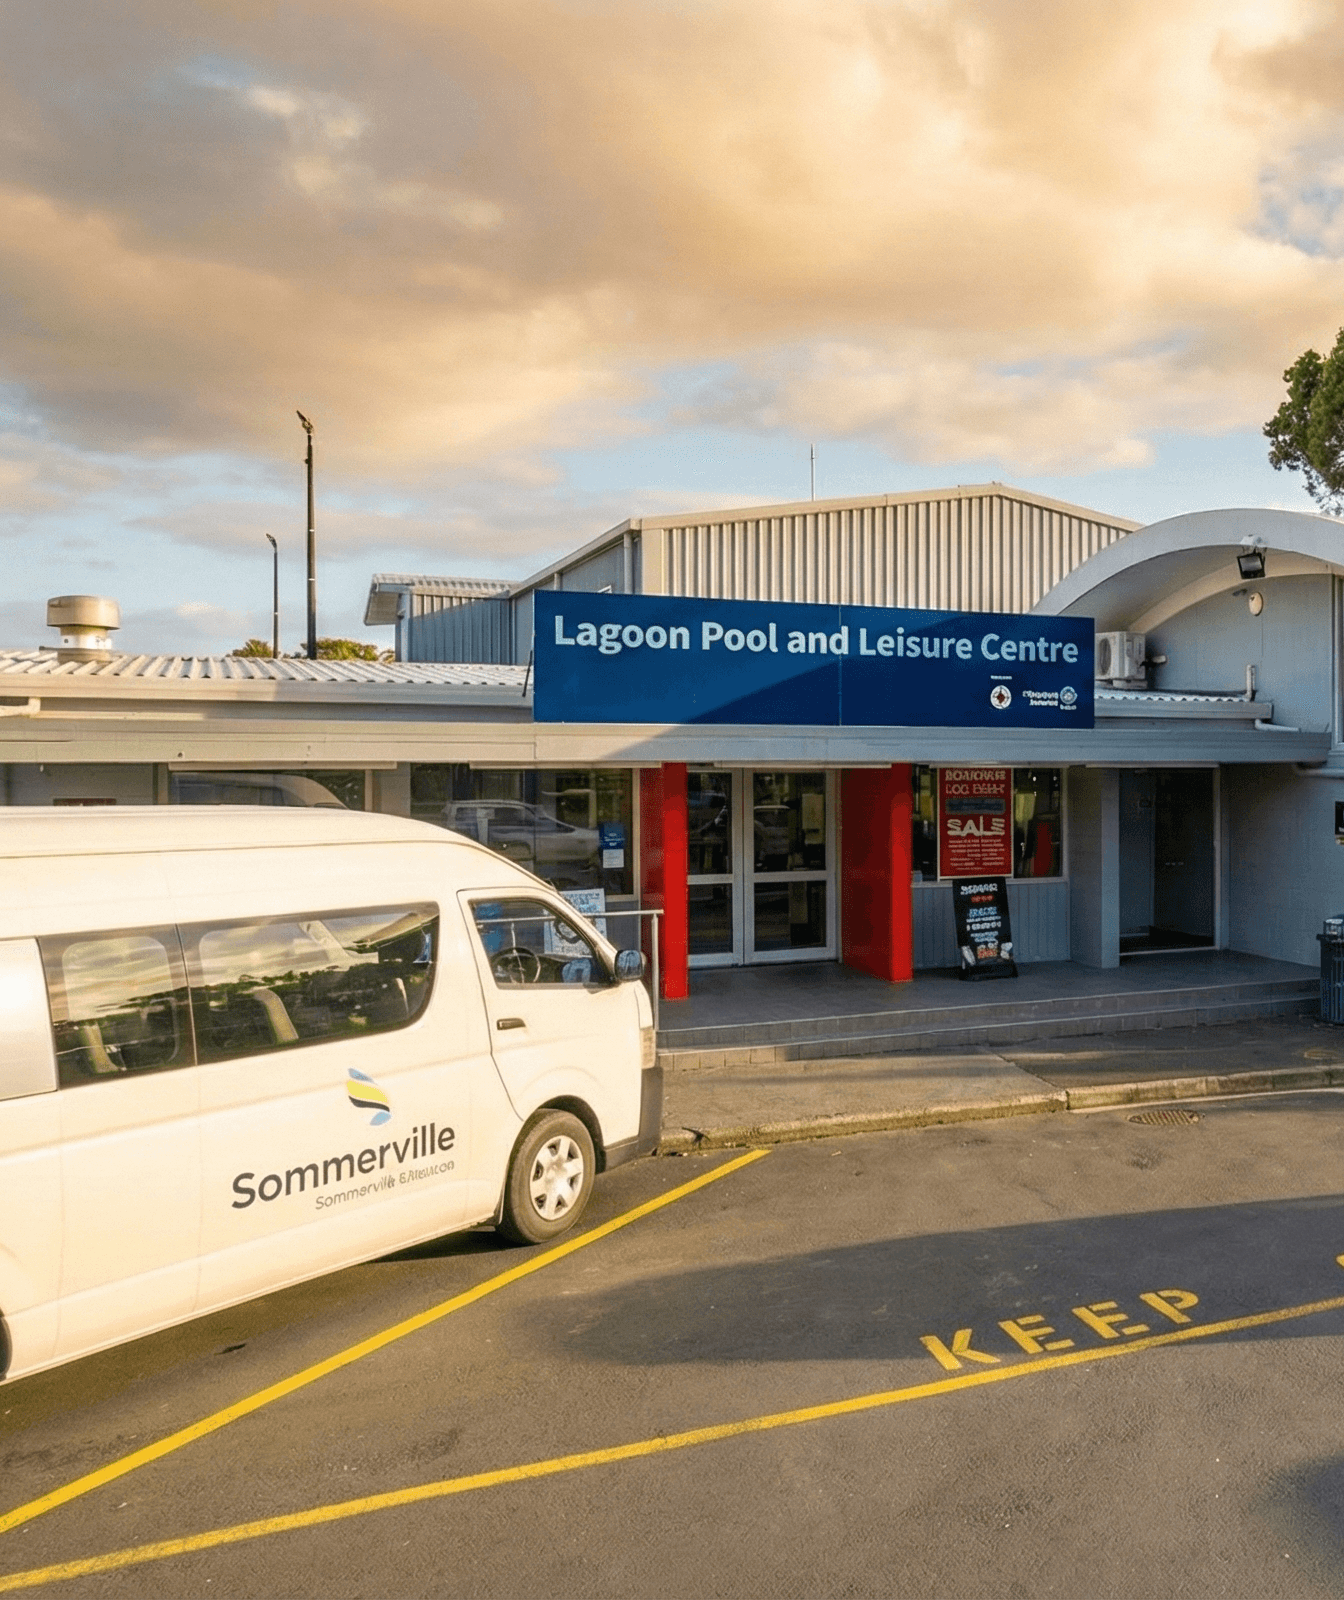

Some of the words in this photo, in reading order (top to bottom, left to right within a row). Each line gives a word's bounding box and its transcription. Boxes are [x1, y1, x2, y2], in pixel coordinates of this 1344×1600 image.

[553, 615, 691, 656] Lagoon
[701, 621, 780, 653] Pool
[787, 625, 850, 656] and
[858, 627, 974, 661] Leisure
[980, 633, 1080, 663] Centre
[946, 814, 1006, 837] SALE
[231, 1122, 456, 1209] Sommerville
[920, 1288, 1200, 1372] KEEP
